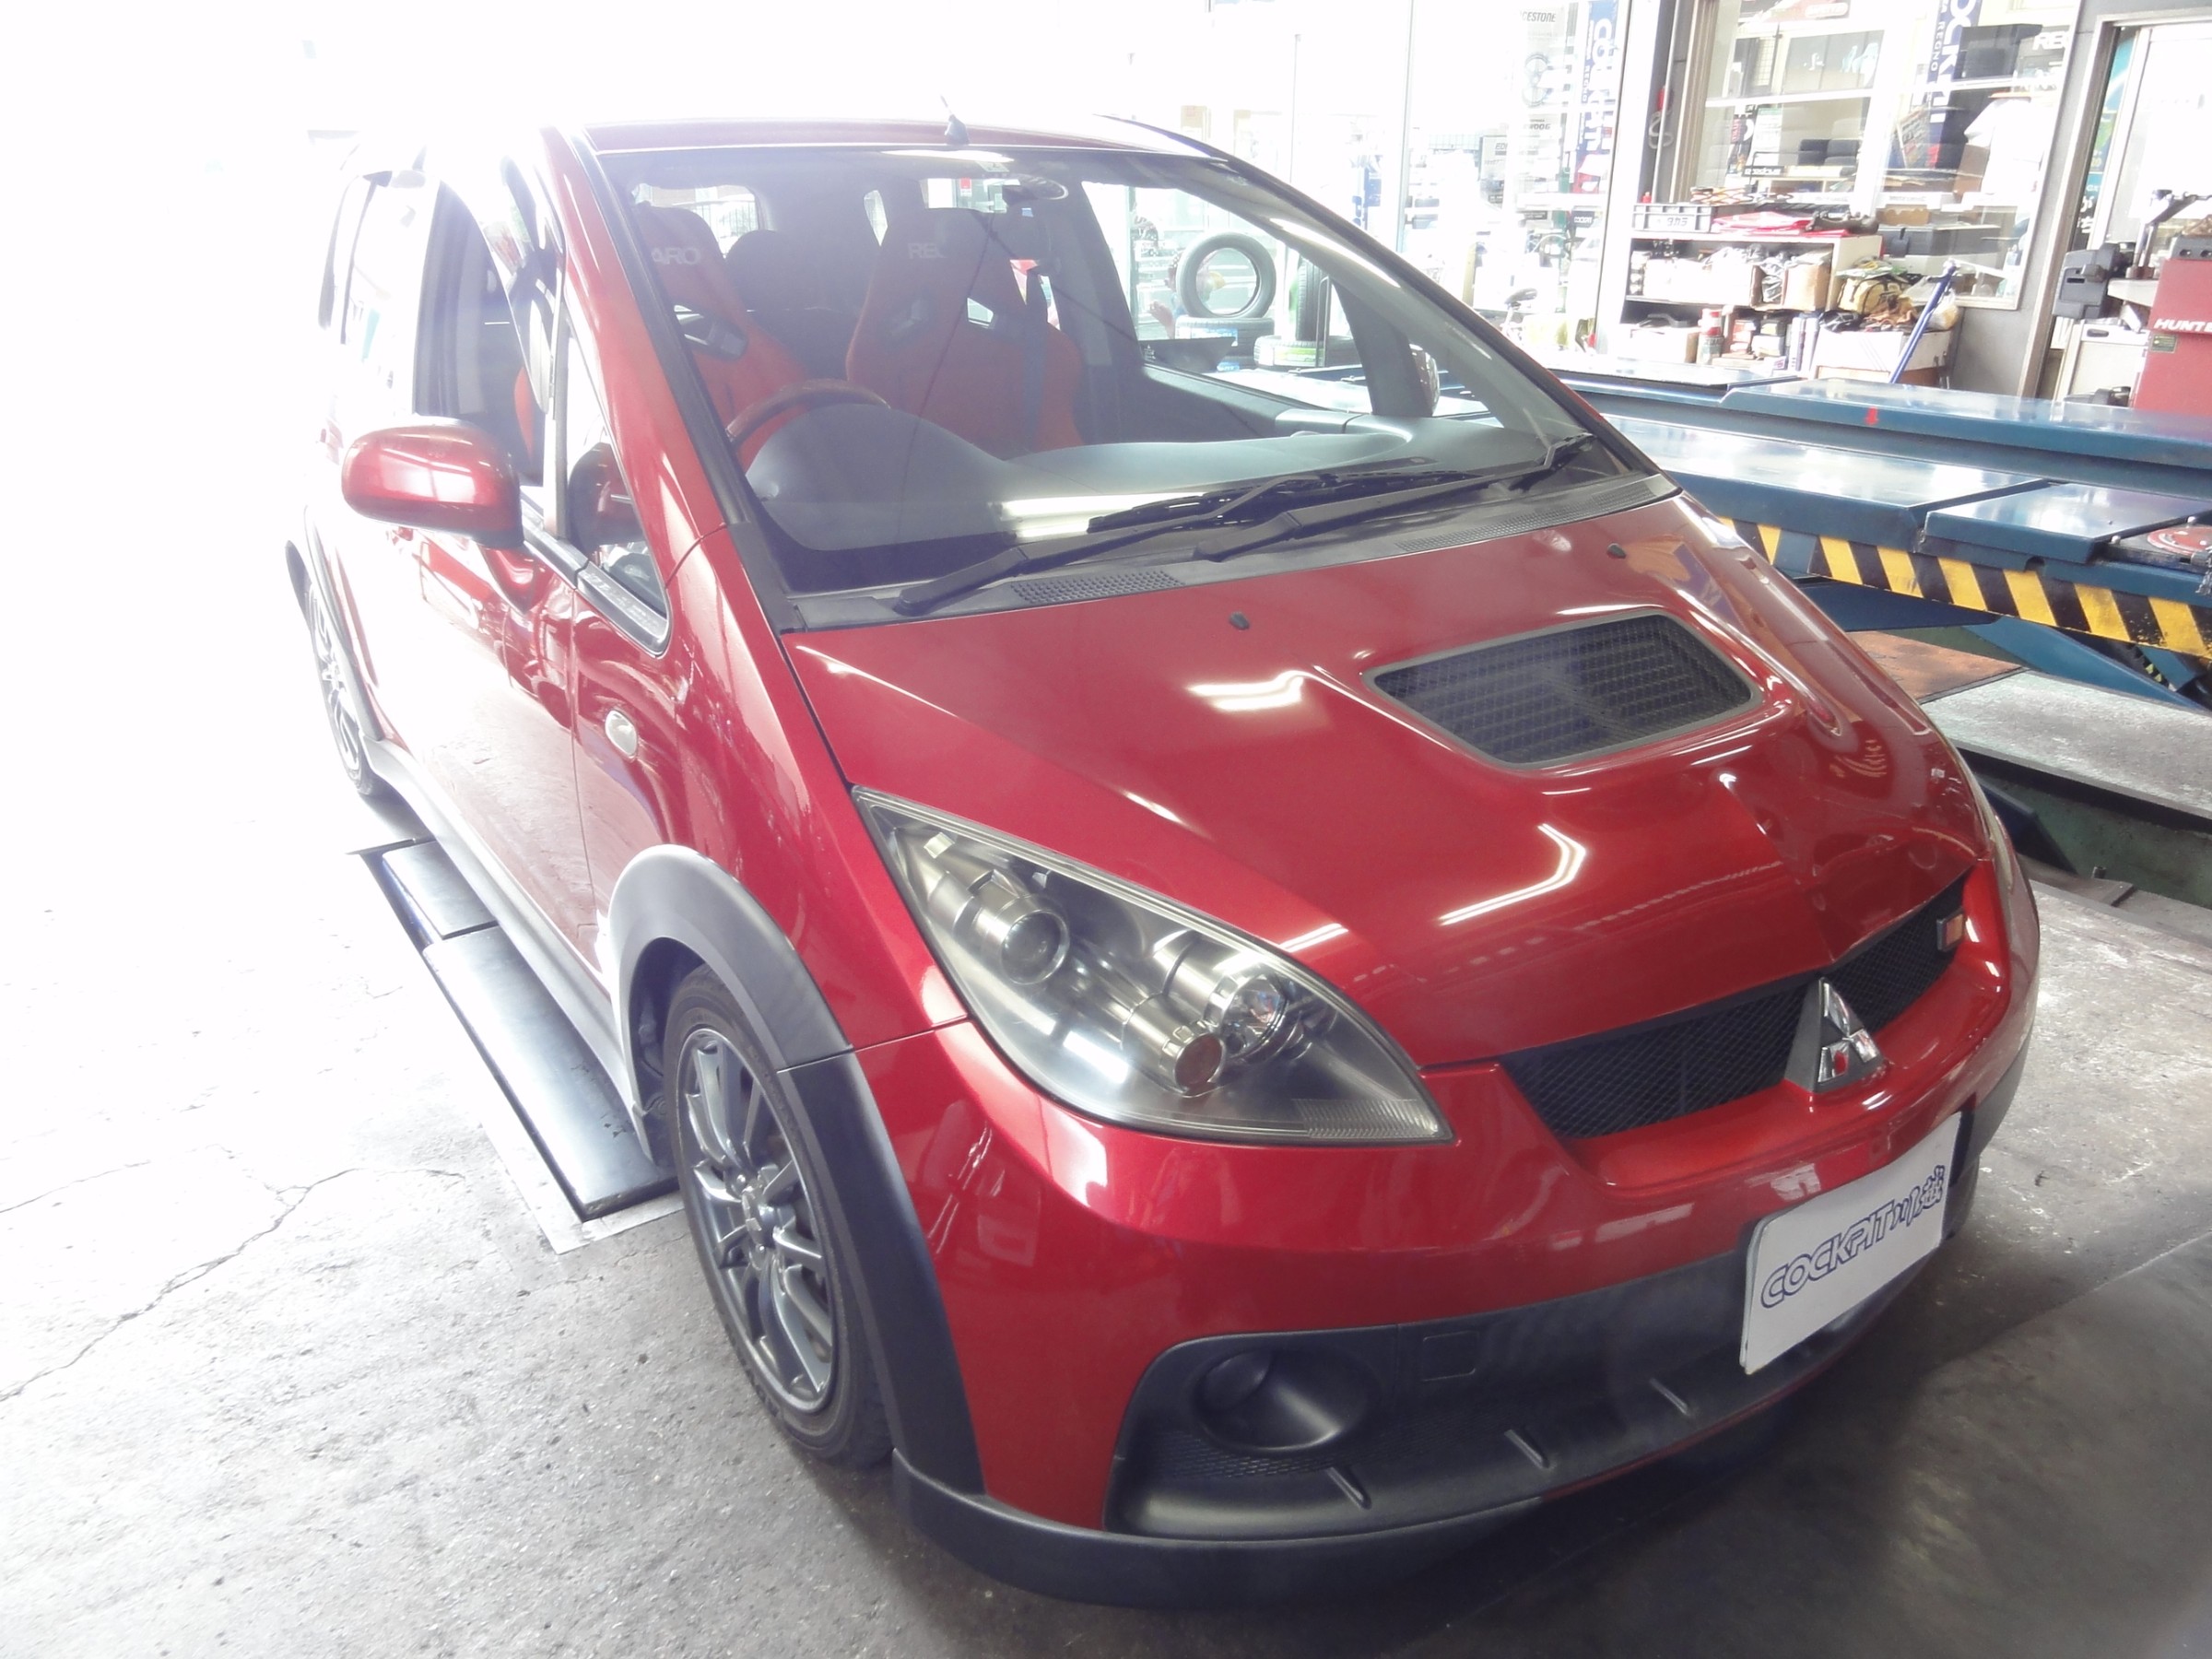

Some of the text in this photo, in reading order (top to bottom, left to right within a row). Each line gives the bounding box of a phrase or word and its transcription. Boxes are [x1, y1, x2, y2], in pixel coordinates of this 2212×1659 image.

[1929, 21, 1945, 72] REGNO
[1666, 217, 1688, 227] タカラ
